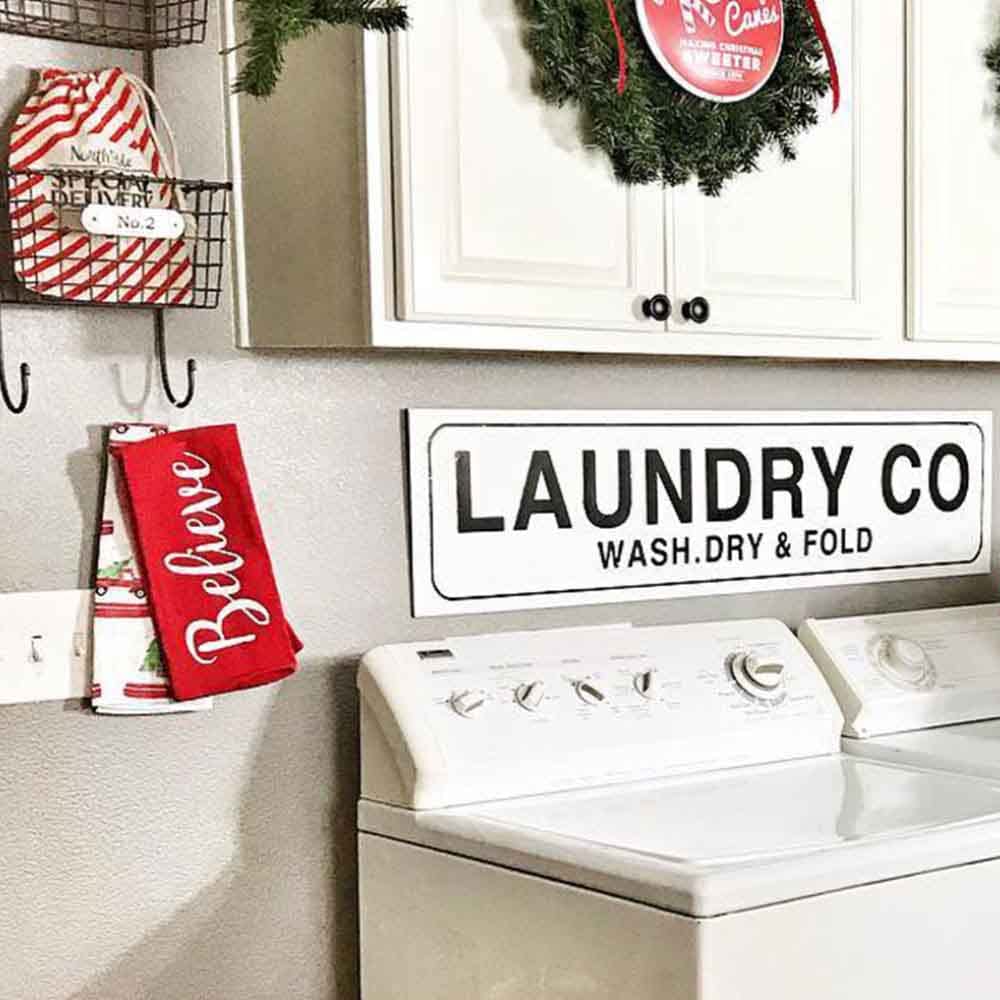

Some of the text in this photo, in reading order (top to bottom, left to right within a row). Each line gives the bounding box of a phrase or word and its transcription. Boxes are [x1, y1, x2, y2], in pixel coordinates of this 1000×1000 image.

[724, 1, 779, 37] Canes
[50, 190, 153, 208] DELIVERY
[117, 215, 155, 231] No.2
[455, 442, 970, 533] LAUNDRY CO
[163, 451, 271, 665] Believe
[597, 527, 874, 569] WASH.DRY & FOLD
